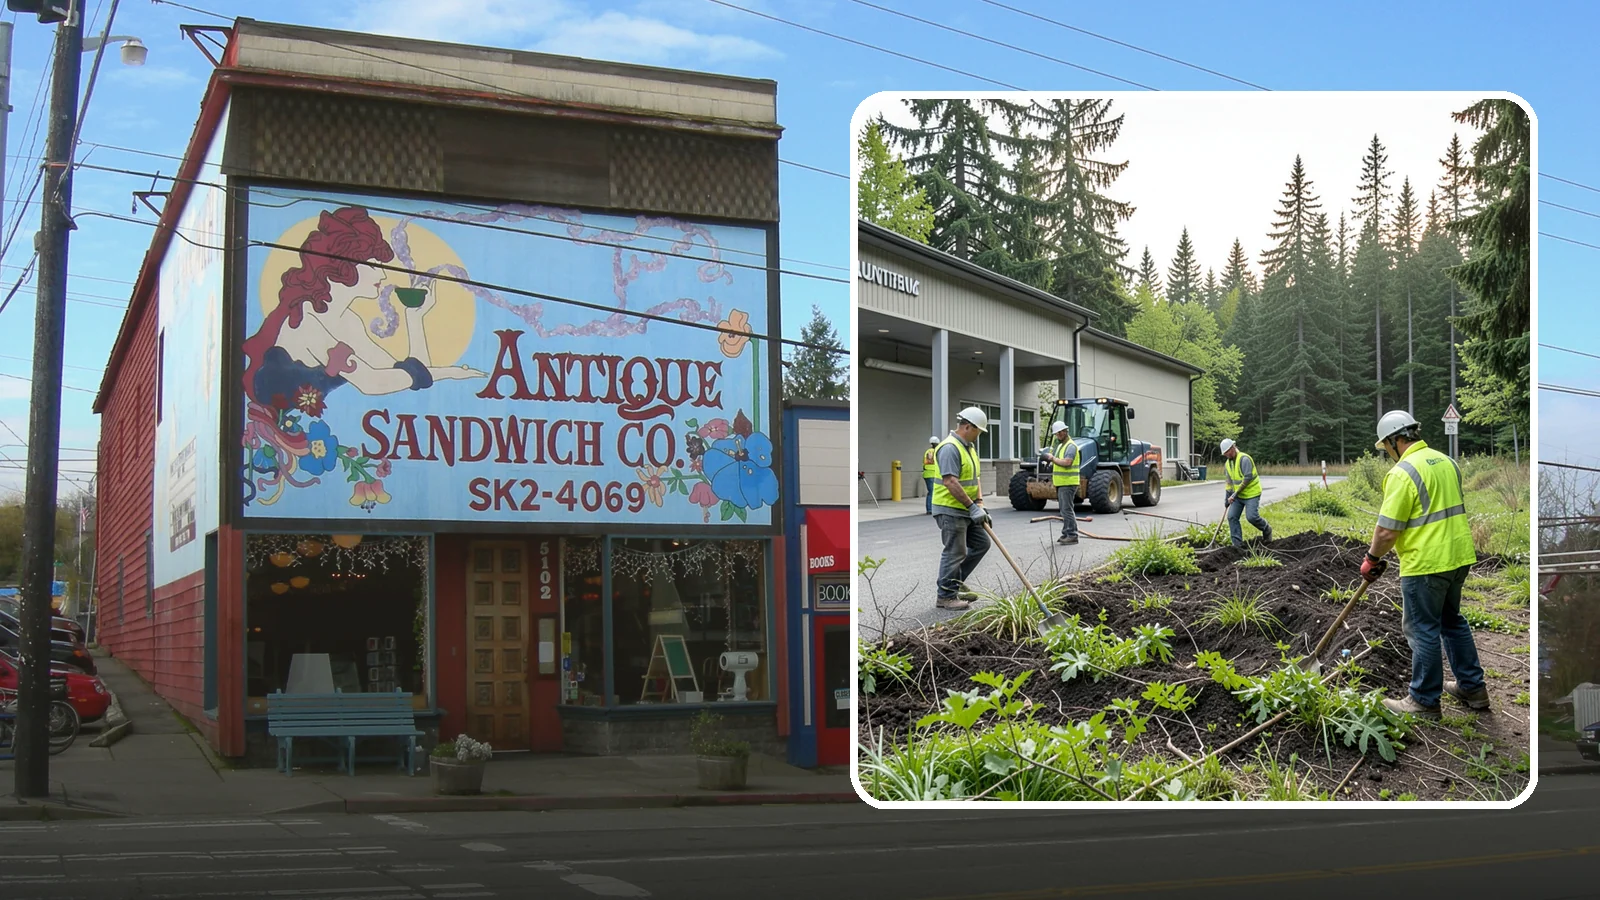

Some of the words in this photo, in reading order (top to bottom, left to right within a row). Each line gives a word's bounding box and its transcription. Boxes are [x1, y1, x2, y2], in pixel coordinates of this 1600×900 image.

[475, 329, 724, 421] ANTIQUE
[361, 408, 605, 468] SANDWICH
[616, 421, 685, 469] CO.
[468, 477, 646, 513] SK2-4069
[539, 542, 551, 600] 5102
[809, 555, 835, 569] BOOKS
